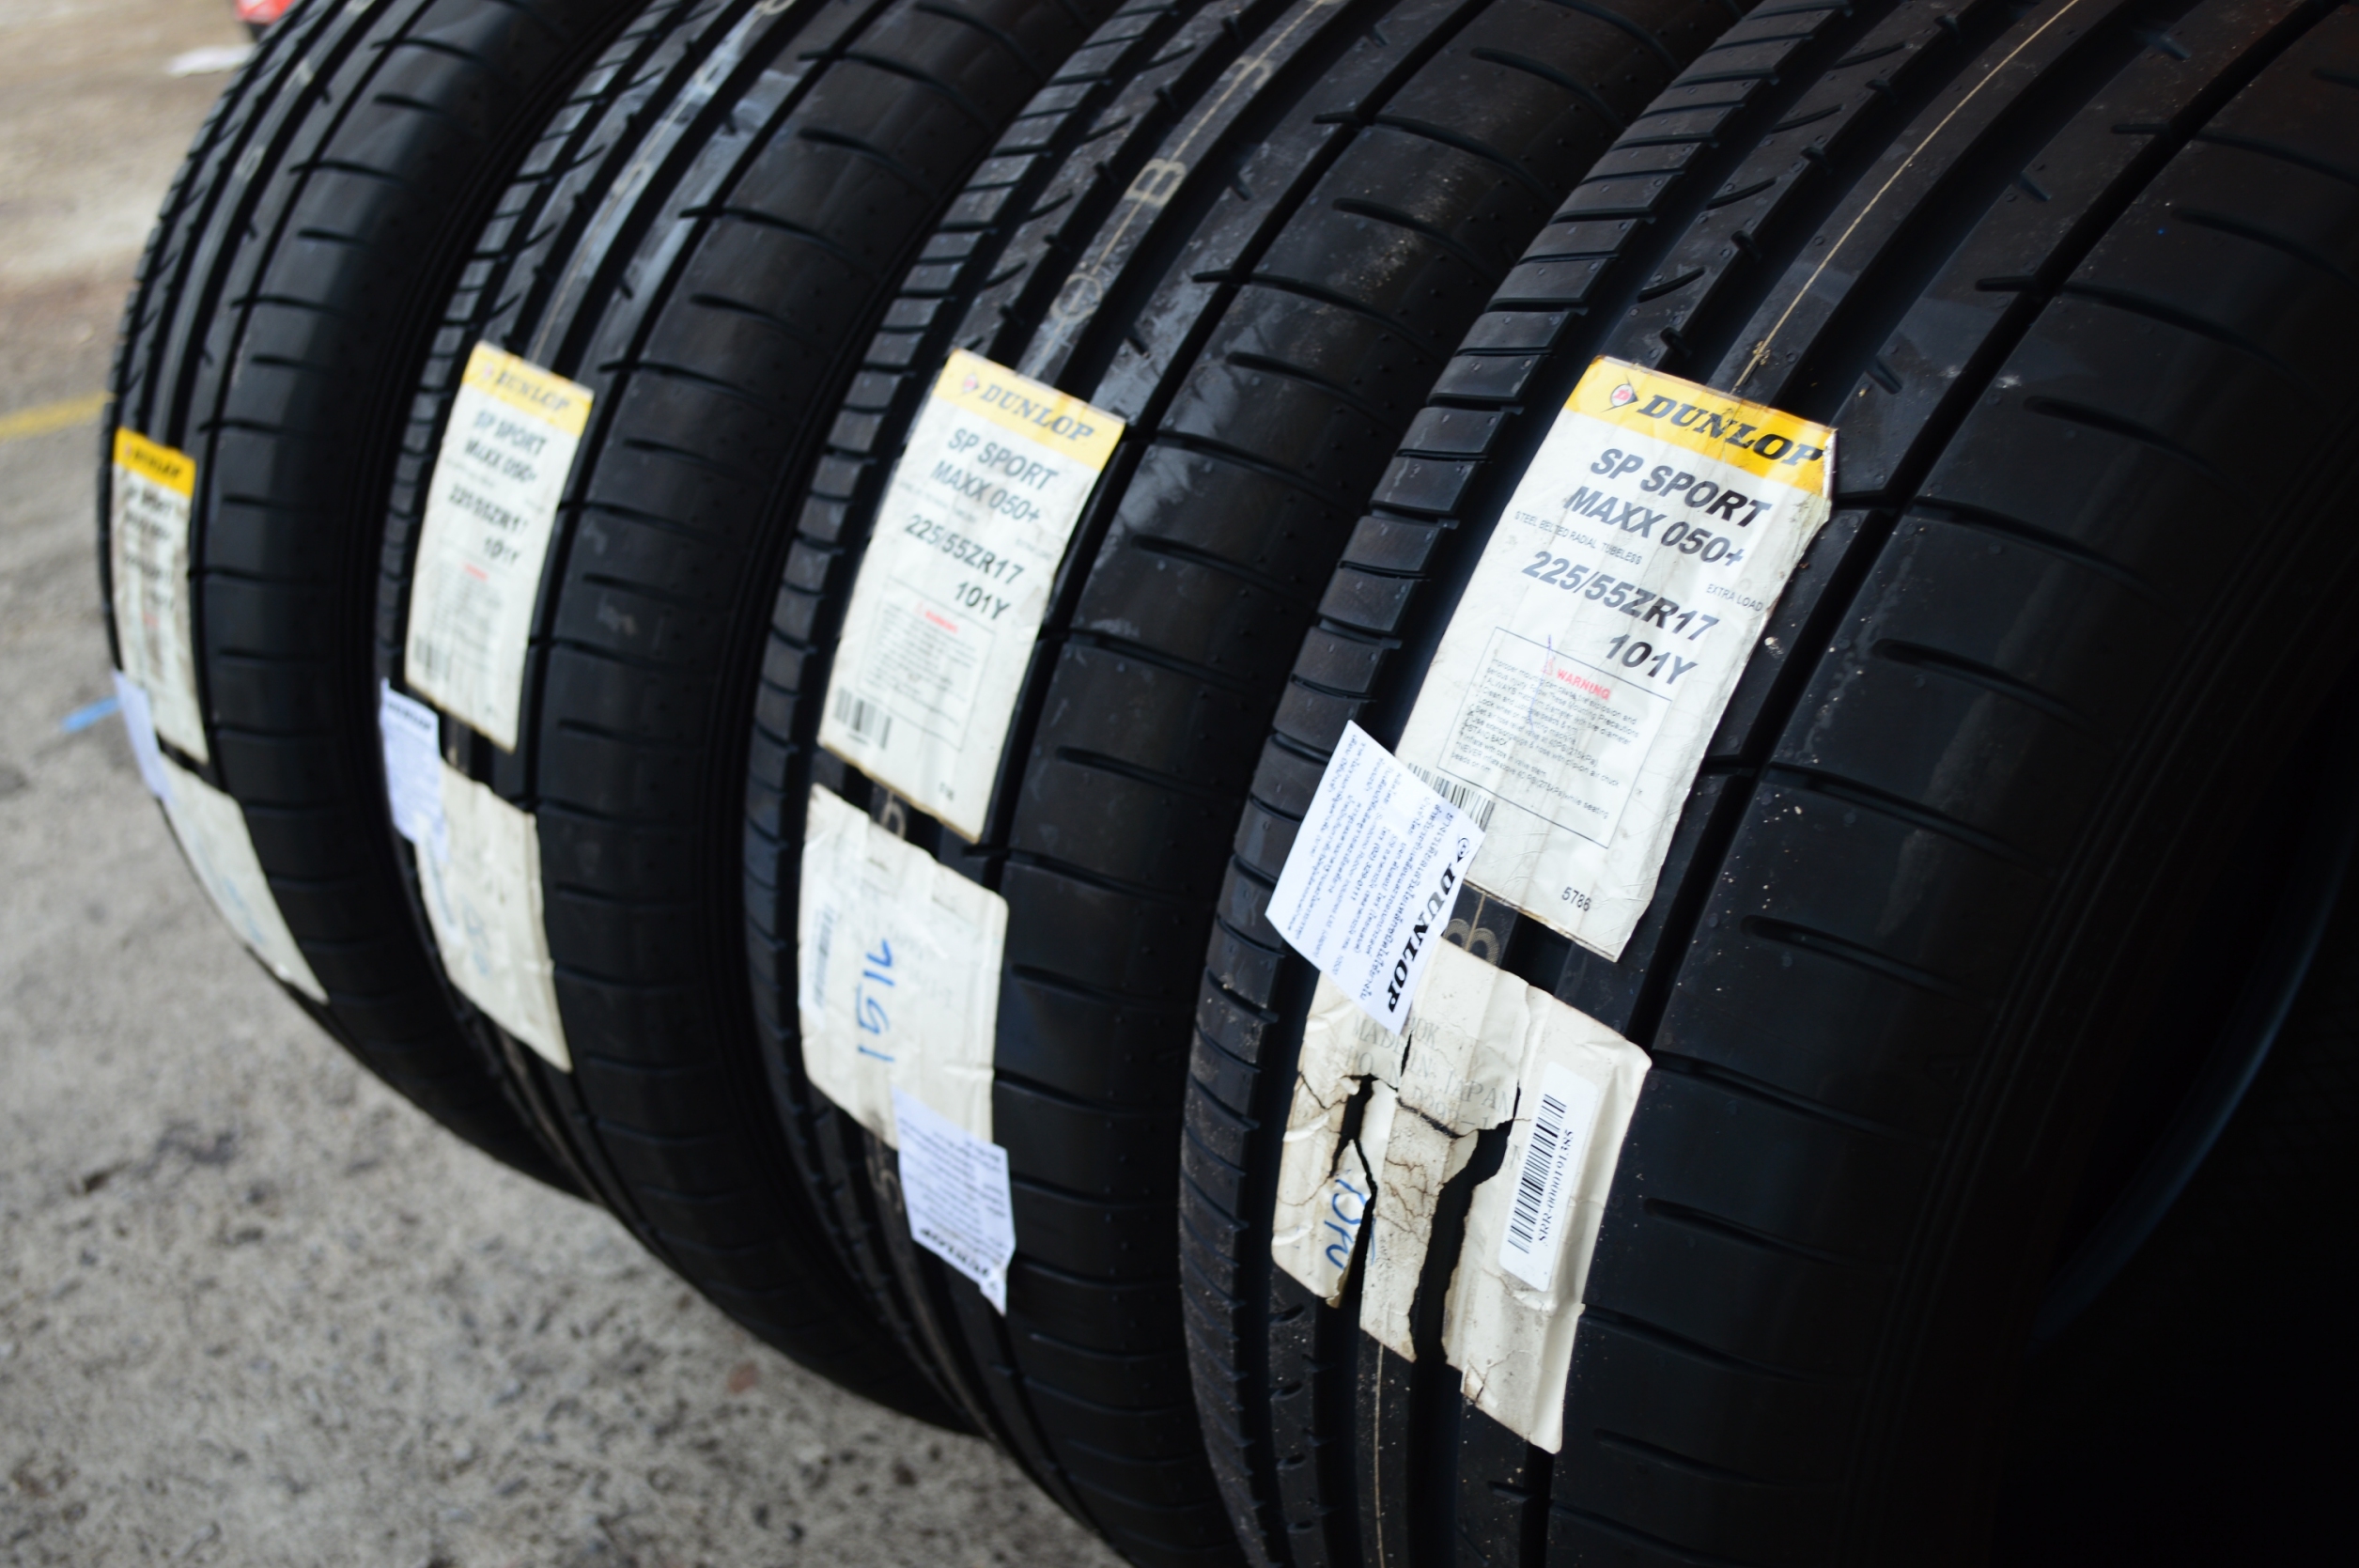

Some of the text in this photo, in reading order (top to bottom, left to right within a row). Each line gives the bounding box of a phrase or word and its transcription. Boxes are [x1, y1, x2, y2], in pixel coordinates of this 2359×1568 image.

[979, 383, 1095, 442] DUNLOP
[1636, 393, 1824, 468] DUNLOP
[931, 459, 989, 502] MAXX
[988, 487, 1042, 523] 050+
[948, 427, 1060, 492] SP SPORT
[1590, 447, 1773, 529] SP SPORT
[904, 514, 1025, 587] 225/55ZR17
[1514, 511, 1643, 566] STEEL BELTED RADIAL TUBELESS
[1564, 486, 1746, 567] MAXX 050+
[953, 580, 1012, 622] 101Y
[1521, 550, 1720, 643] 225/55ZR17
[1705, 582, 1764, 613] EXTRA LOAD
[1555, 668, 1611, 700] WARNING
[1605, 633, 1699, 687] 101Y
[1560, 885, 1592, 913] 5786
[1380, 861, 1459, 1013] DUNLOP
